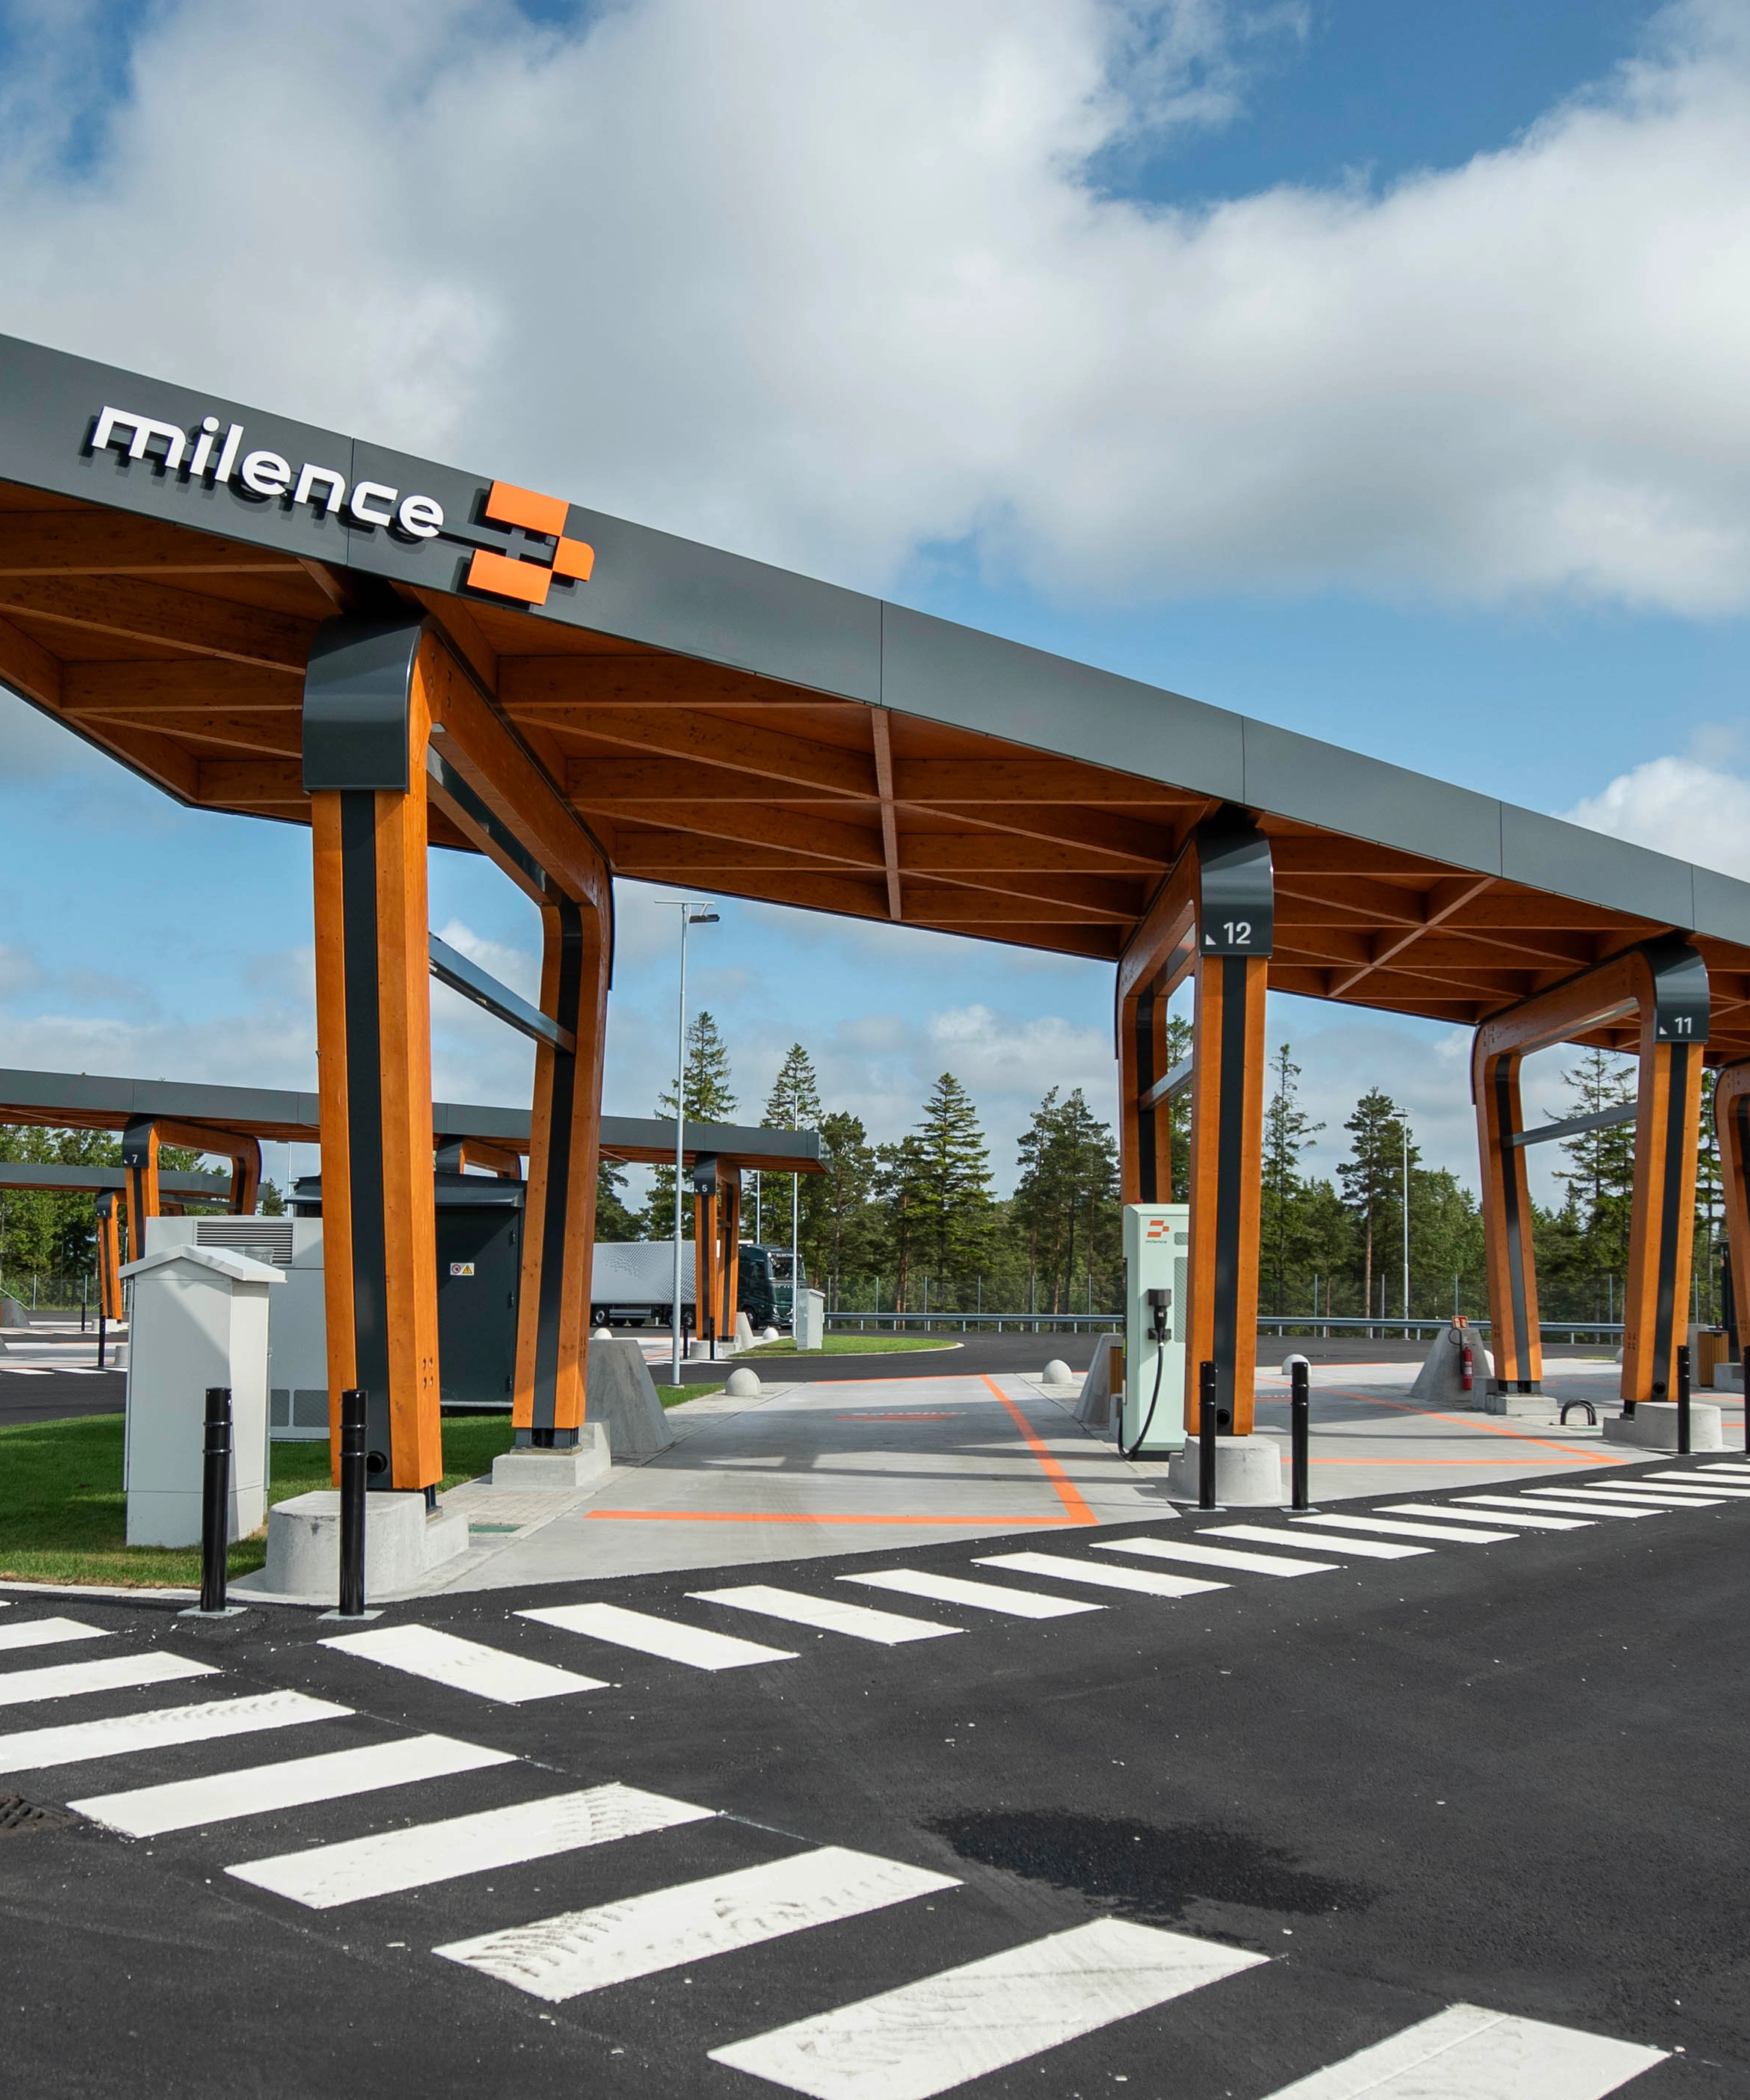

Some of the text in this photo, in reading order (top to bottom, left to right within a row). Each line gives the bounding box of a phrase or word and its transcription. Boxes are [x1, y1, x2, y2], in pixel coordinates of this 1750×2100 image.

[91, 405, 444, 538] milence
[1223, 922, 1251, 944] 12
[1675, 1017, 1692, 1034] 11
[132, 1154, 138, 1163] 7
[702, 1184, 708, 1192] 5
